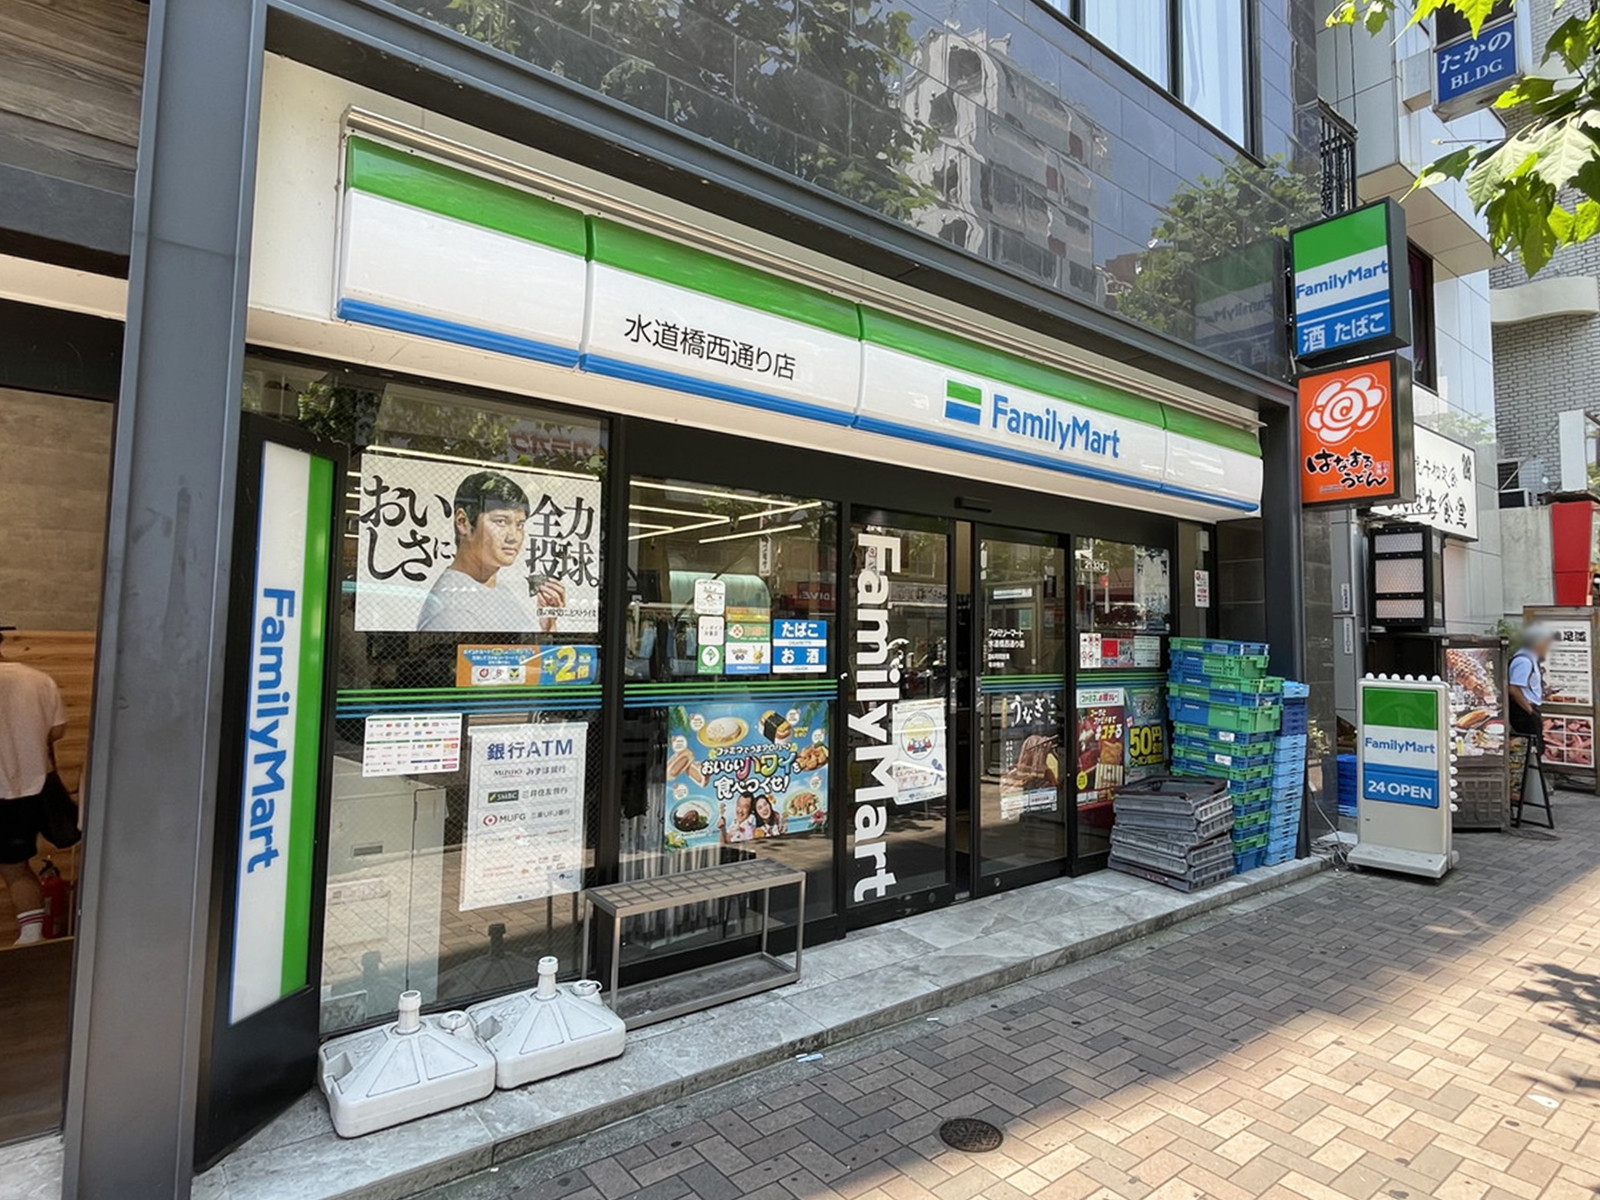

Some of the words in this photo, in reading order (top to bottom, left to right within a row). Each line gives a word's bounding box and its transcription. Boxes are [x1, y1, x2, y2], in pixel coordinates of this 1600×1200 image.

[1441, 31, 1512, 74] たかの
[1296, 260, 1388, 299] FamilyMart
[624, 314, 796, 381] 水道橋西通り店
[1303, 324, 1326, 352] 酒
[1334, 312, 1386, 342] たばこ
[991, 394, 1120, 458] FamilyMart
[1306, 448, 1374, 473] はなまる
[1340, 470, 1387, 489] うどん
[360, 475, 452, 528] おい
[527, 494, 596, 541] 全力
[782, 621, 819, 638] たばこ
[848, 533, 901, 903] FamilyMart
[1010, 694, 1045, 727] うなぎ
[247, 587, 296, 874] FamilyMart
[1365, 737, 1435, 755] FamilyMart
[487, 739, 573, 760] 銀行ATM
[702, 752, 801, 780] おいしいハワイを
[496, 792, 518, 800] SMBC
[1368, 780, 1386, 794] 24
[1387, 782, 1432, 800] OPEN
[500, 813, 526, 823] MUFG
